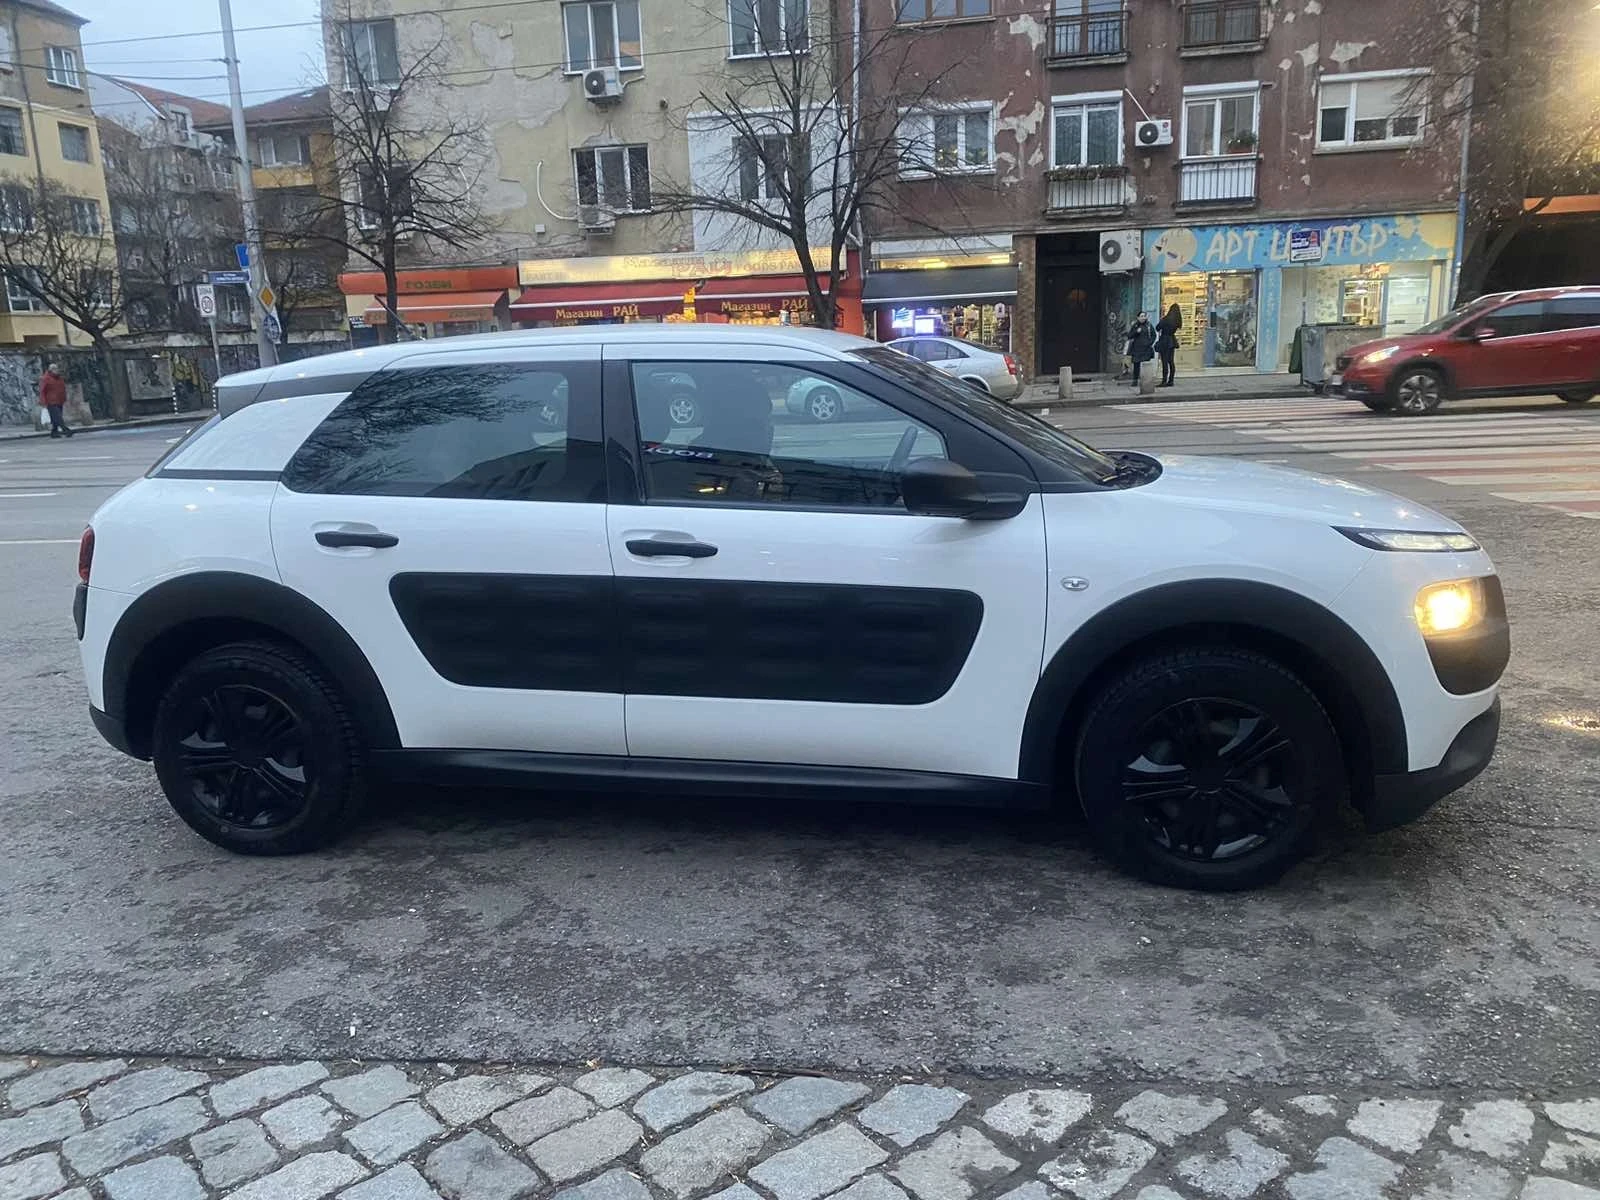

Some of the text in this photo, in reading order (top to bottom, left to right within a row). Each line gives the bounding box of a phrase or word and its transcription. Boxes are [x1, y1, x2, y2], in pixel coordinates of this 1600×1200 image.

[1205, 229, 1258, 264] АРТ
[555, 304, 639, 320] Магазин РАЙ
[721, 296, 808, 313] Магазин РАЙ
